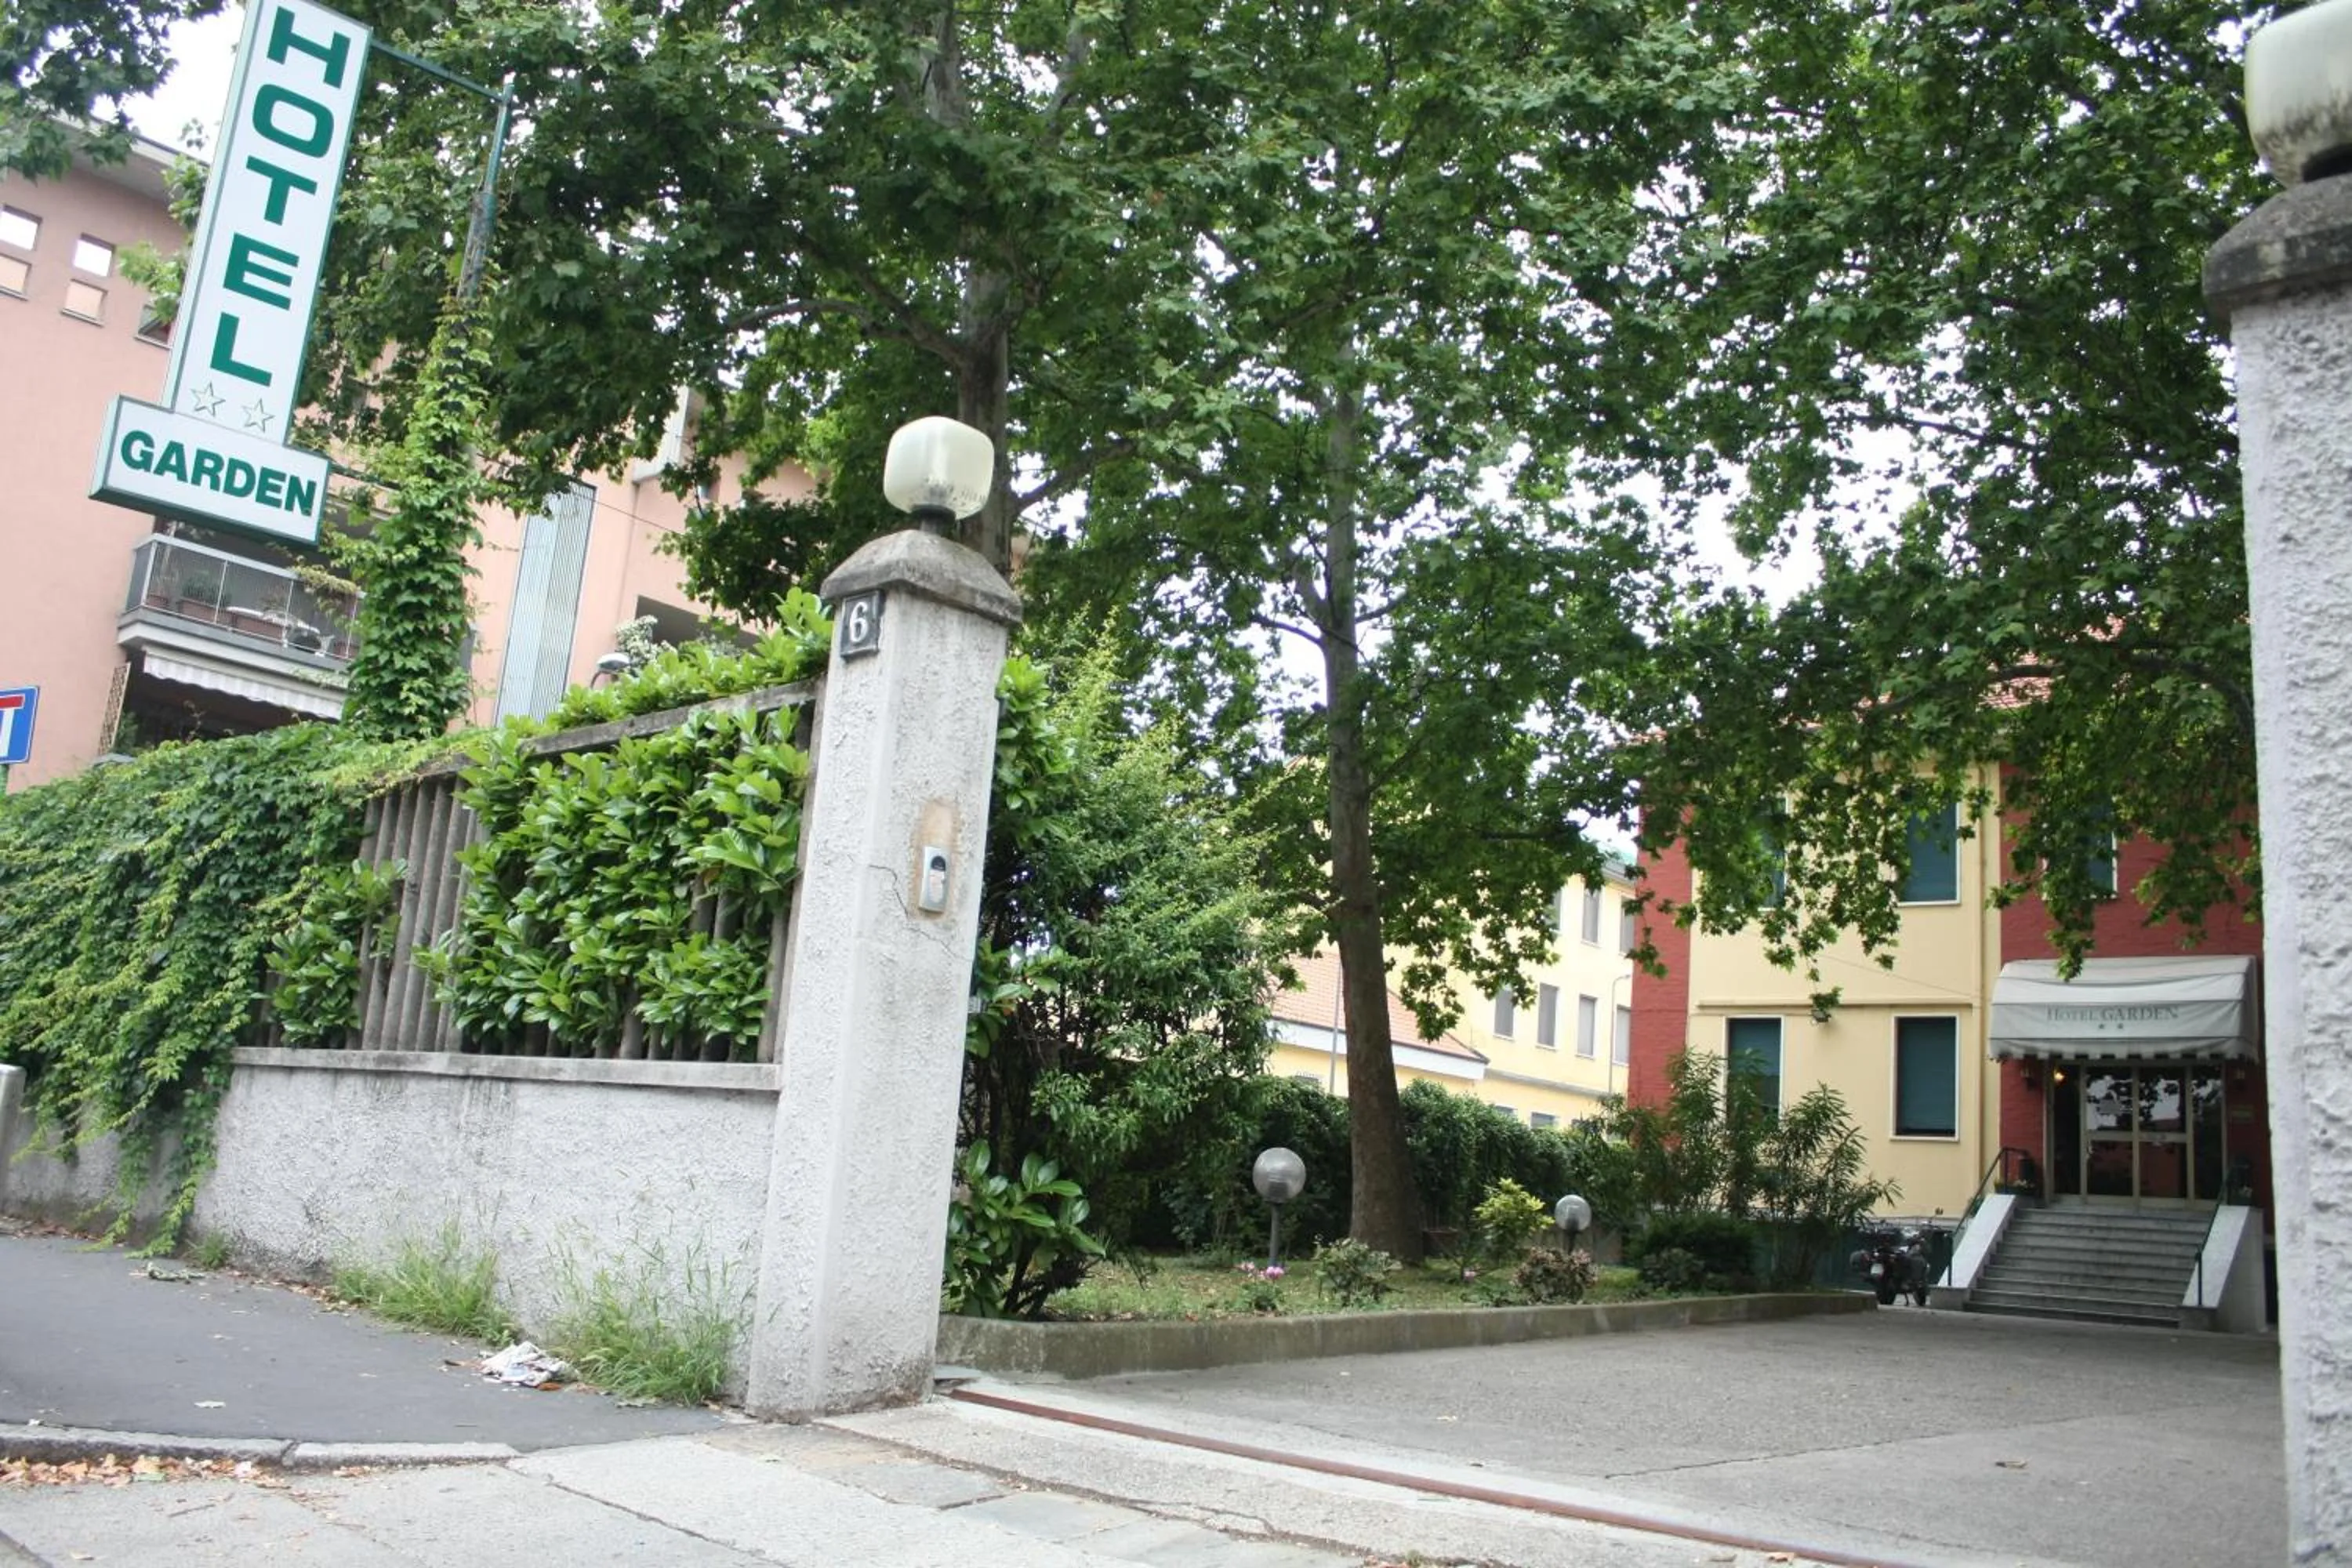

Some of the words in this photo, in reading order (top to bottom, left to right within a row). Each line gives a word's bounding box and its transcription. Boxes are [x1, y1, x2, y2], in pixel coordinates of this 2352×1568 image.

[209, 5, 350, 387] HOTEL
[120, 430, 317, 517] GARDEN
[849, 601, 868, 642] 6
[2101, 1004, 2179, 1022] GARDEN
